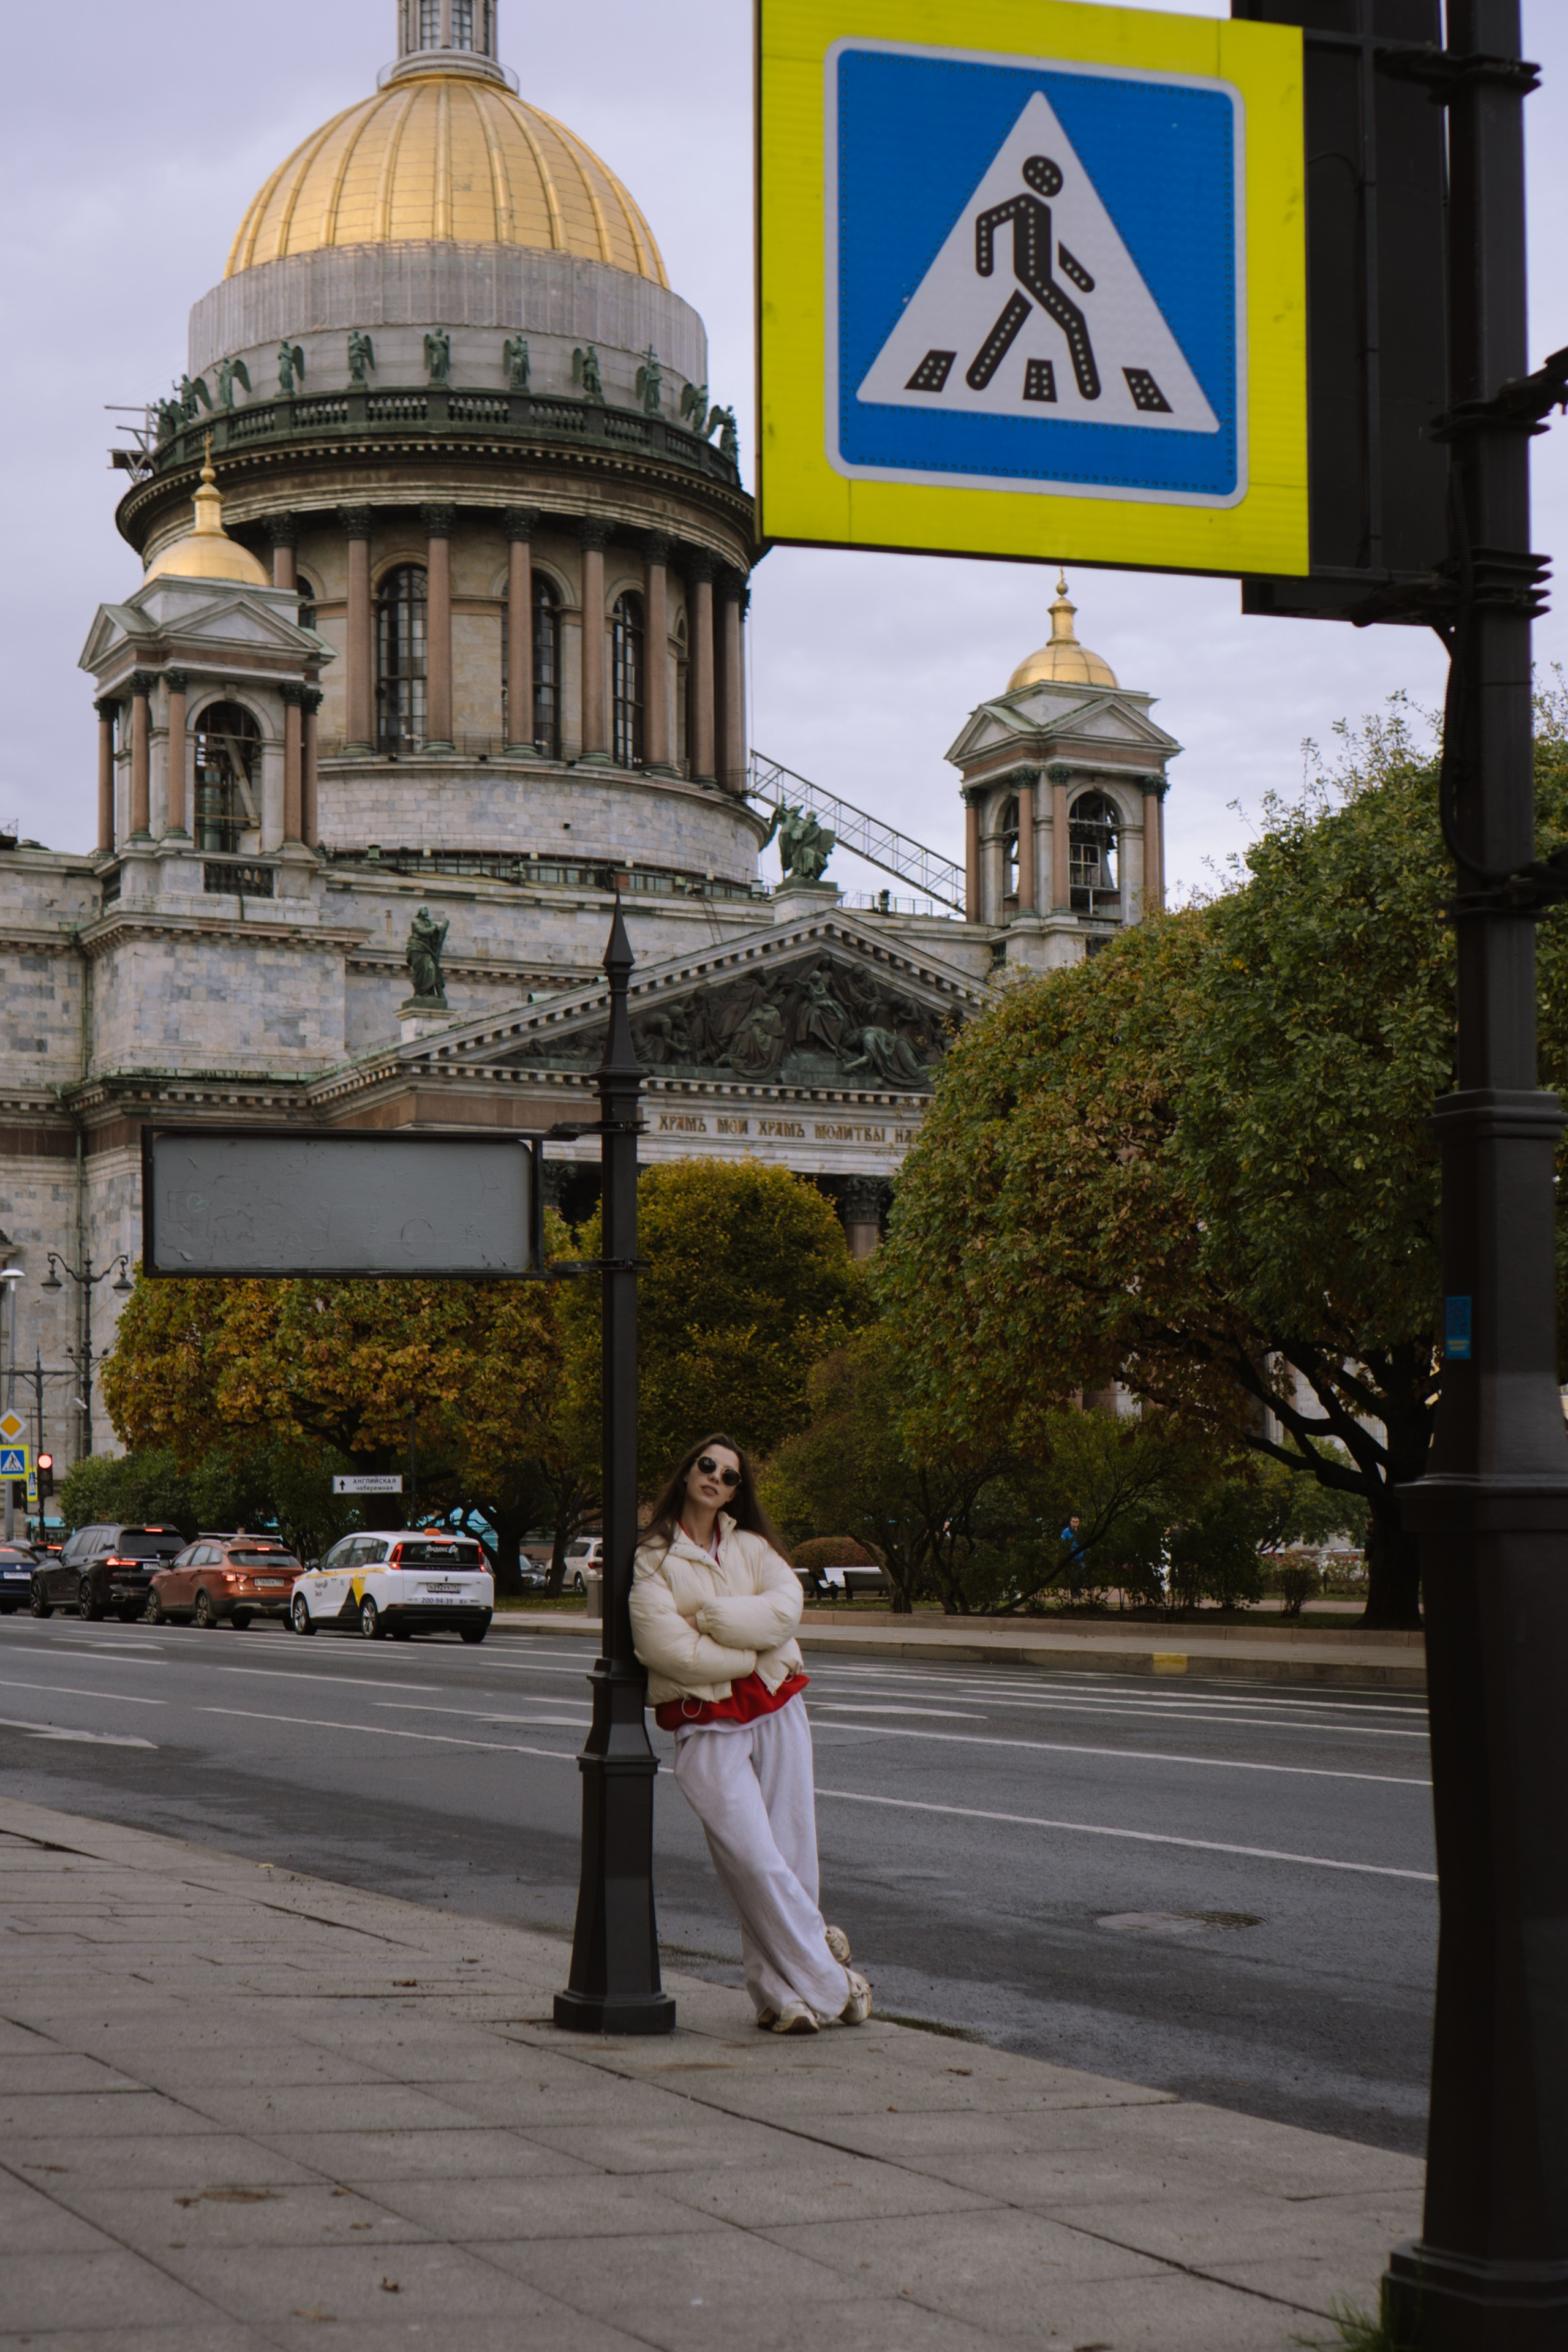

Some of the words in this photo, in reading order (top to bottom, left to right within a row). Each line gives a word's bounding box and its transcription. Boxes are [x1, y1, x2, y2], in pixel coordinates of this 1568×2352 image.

[659, 1115, 706, 1132] ХРАМЪ
[758, 1120, 805, 1138] ХРАМЪ
[426, 1545, 448, 1553] Яндекс
